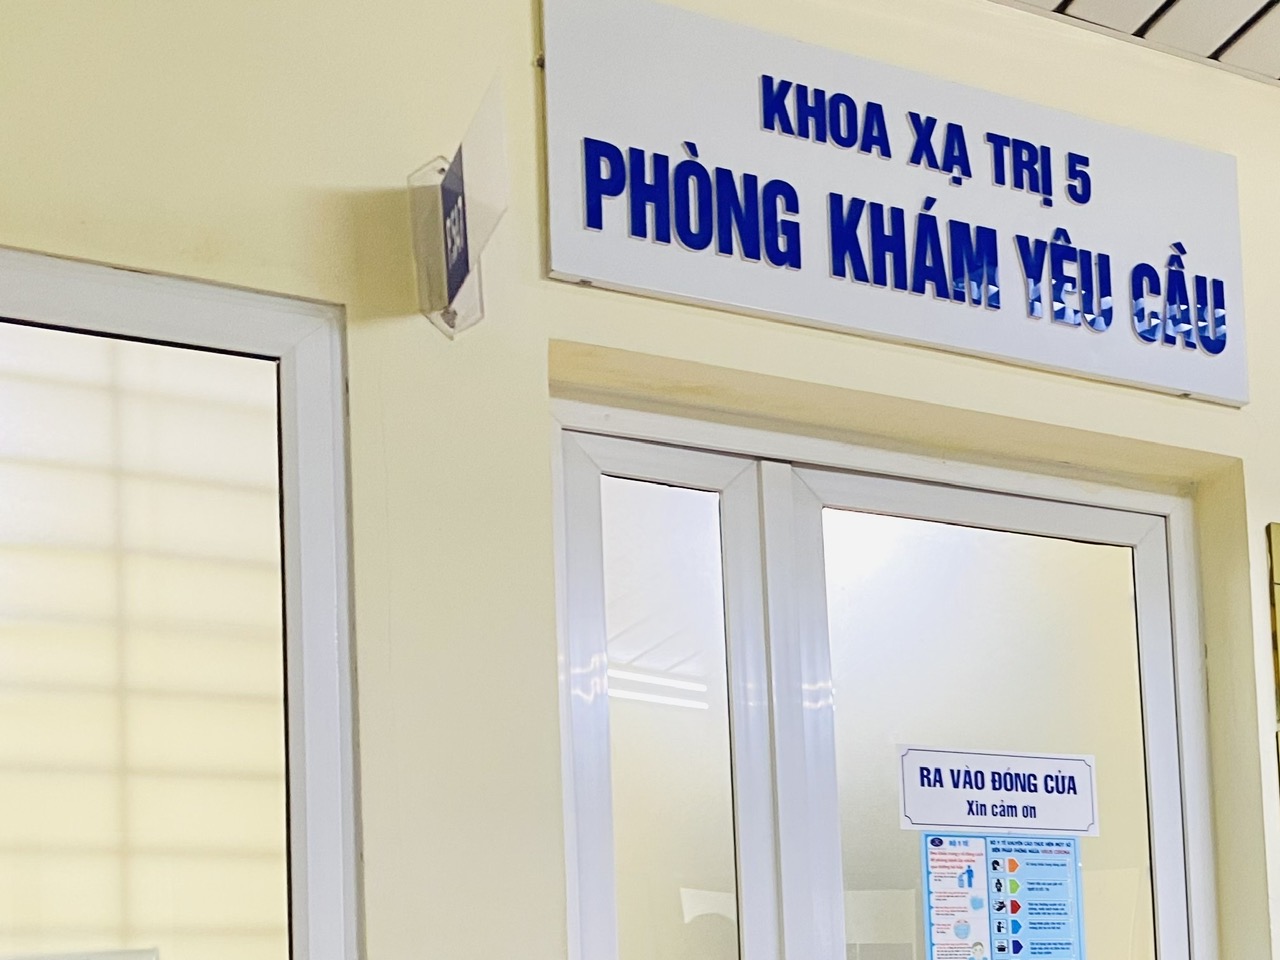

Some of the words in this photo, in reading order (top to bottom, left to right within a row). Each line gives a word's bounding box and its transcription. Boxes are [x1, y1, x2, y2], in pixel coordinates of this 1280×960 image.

[761, 74, 893, 159] KHOA
[907, 111, 973, 186] XẠ
[985, 132, 1053, 208] TRỊ
[1066, 151, 1092, 205] 5
[582, 137, 802, 271] PHÒNG
[828, 193, 1001, 311] KHÁM
[1015, 228, 1114, 333] YÊU
[1132, 241, 1228, 356] CẦU
[919, 766, 944, 788] RA
[950, 764, 985, 790] VÀO
[991, 767, 1038, 793] ĐÓNG
[1043, 770, 1078, 795] CỬA
[966, 800, 987, 817] Xin
[991, 800, 1018, 818] cảm
[1022, 805, 1037, 818] ơn
